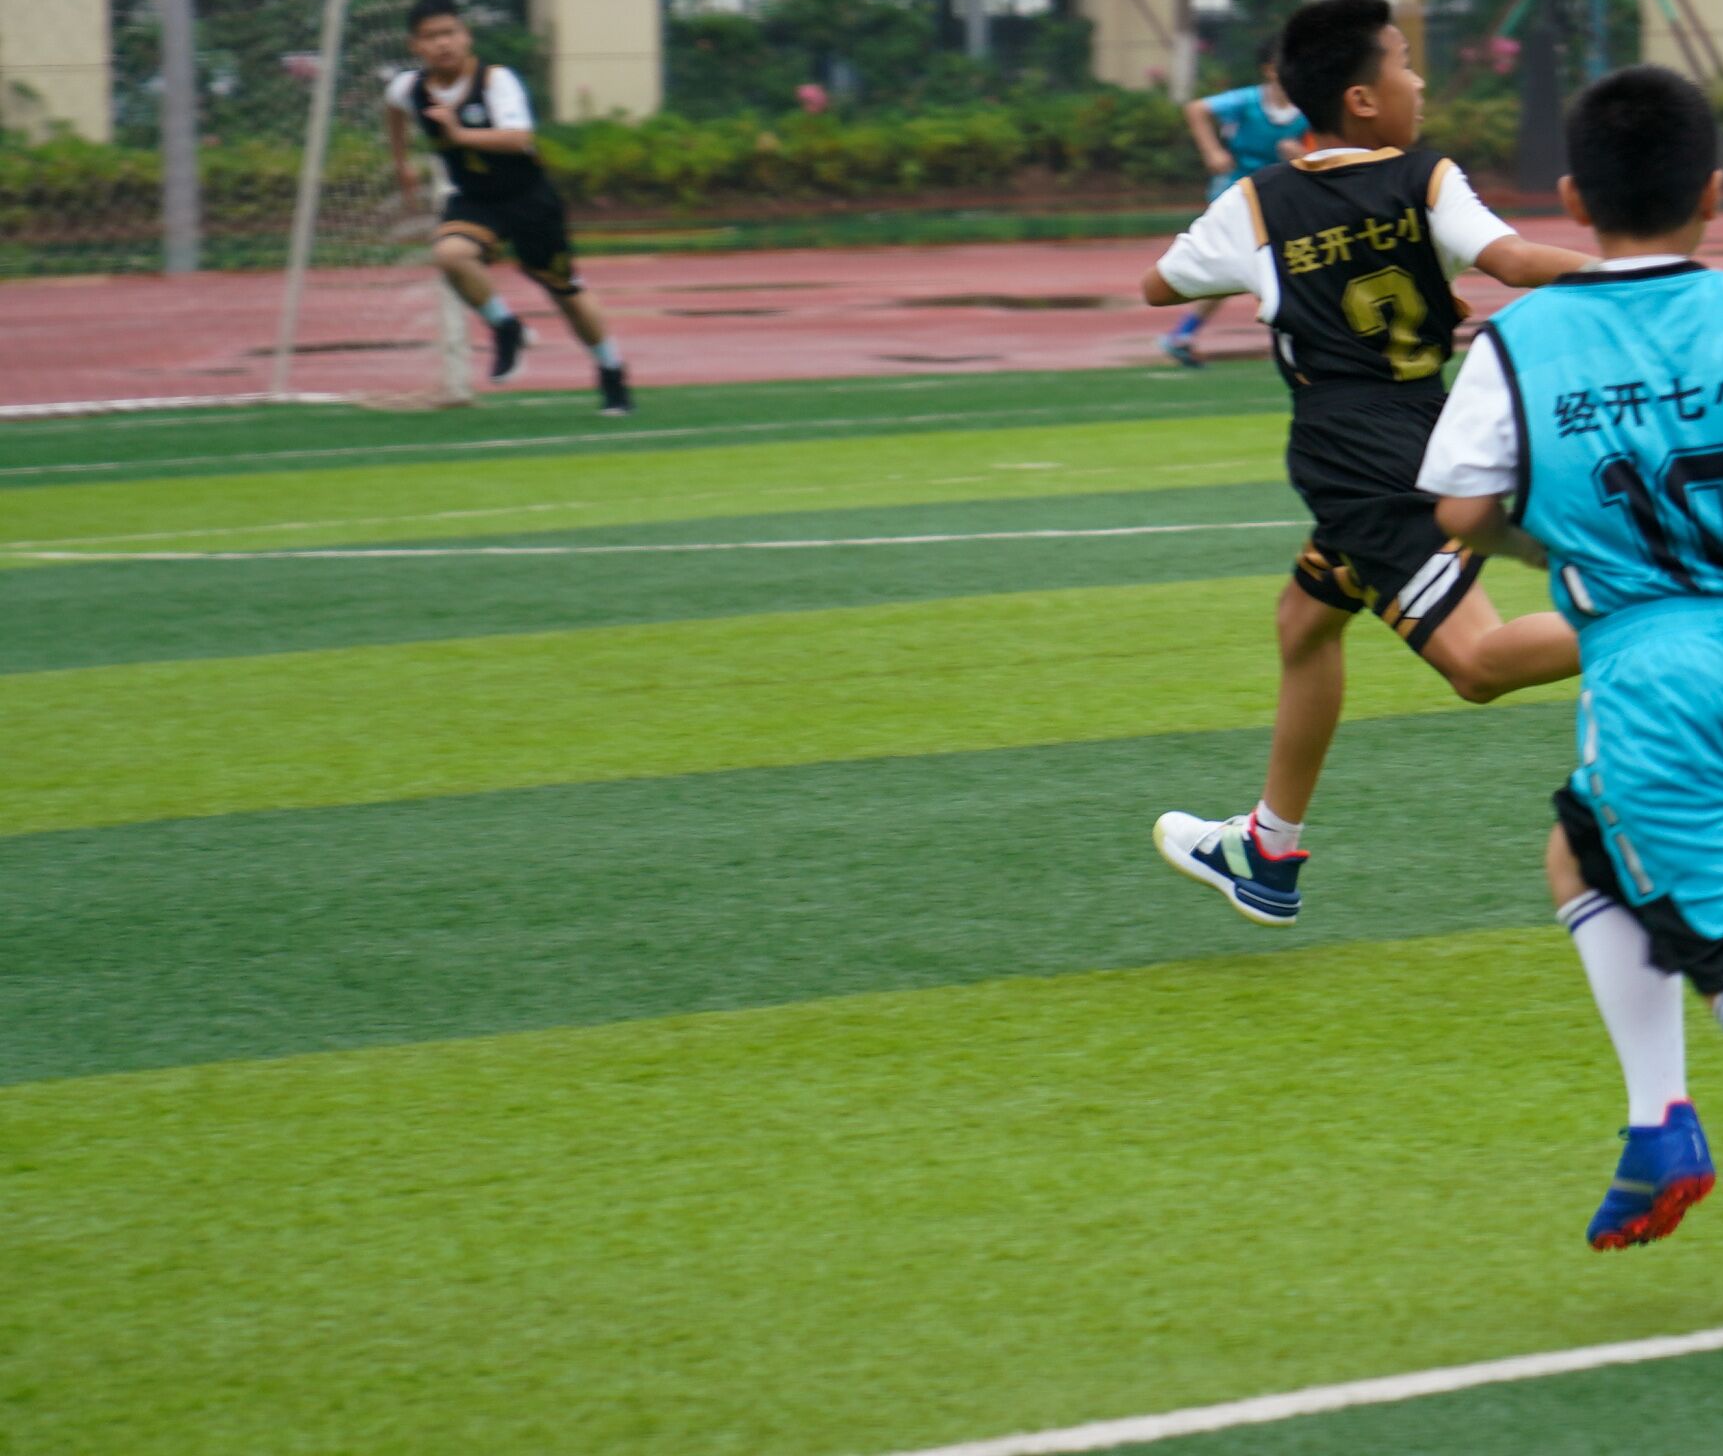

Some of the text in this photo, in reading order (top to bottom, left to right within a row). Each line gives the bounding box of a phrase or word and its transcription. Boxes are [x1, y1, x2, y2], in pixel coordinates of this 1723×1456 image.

[1283, 207, 1422, 276] 经开七小
[1340, 264, 1444, 382] 2
